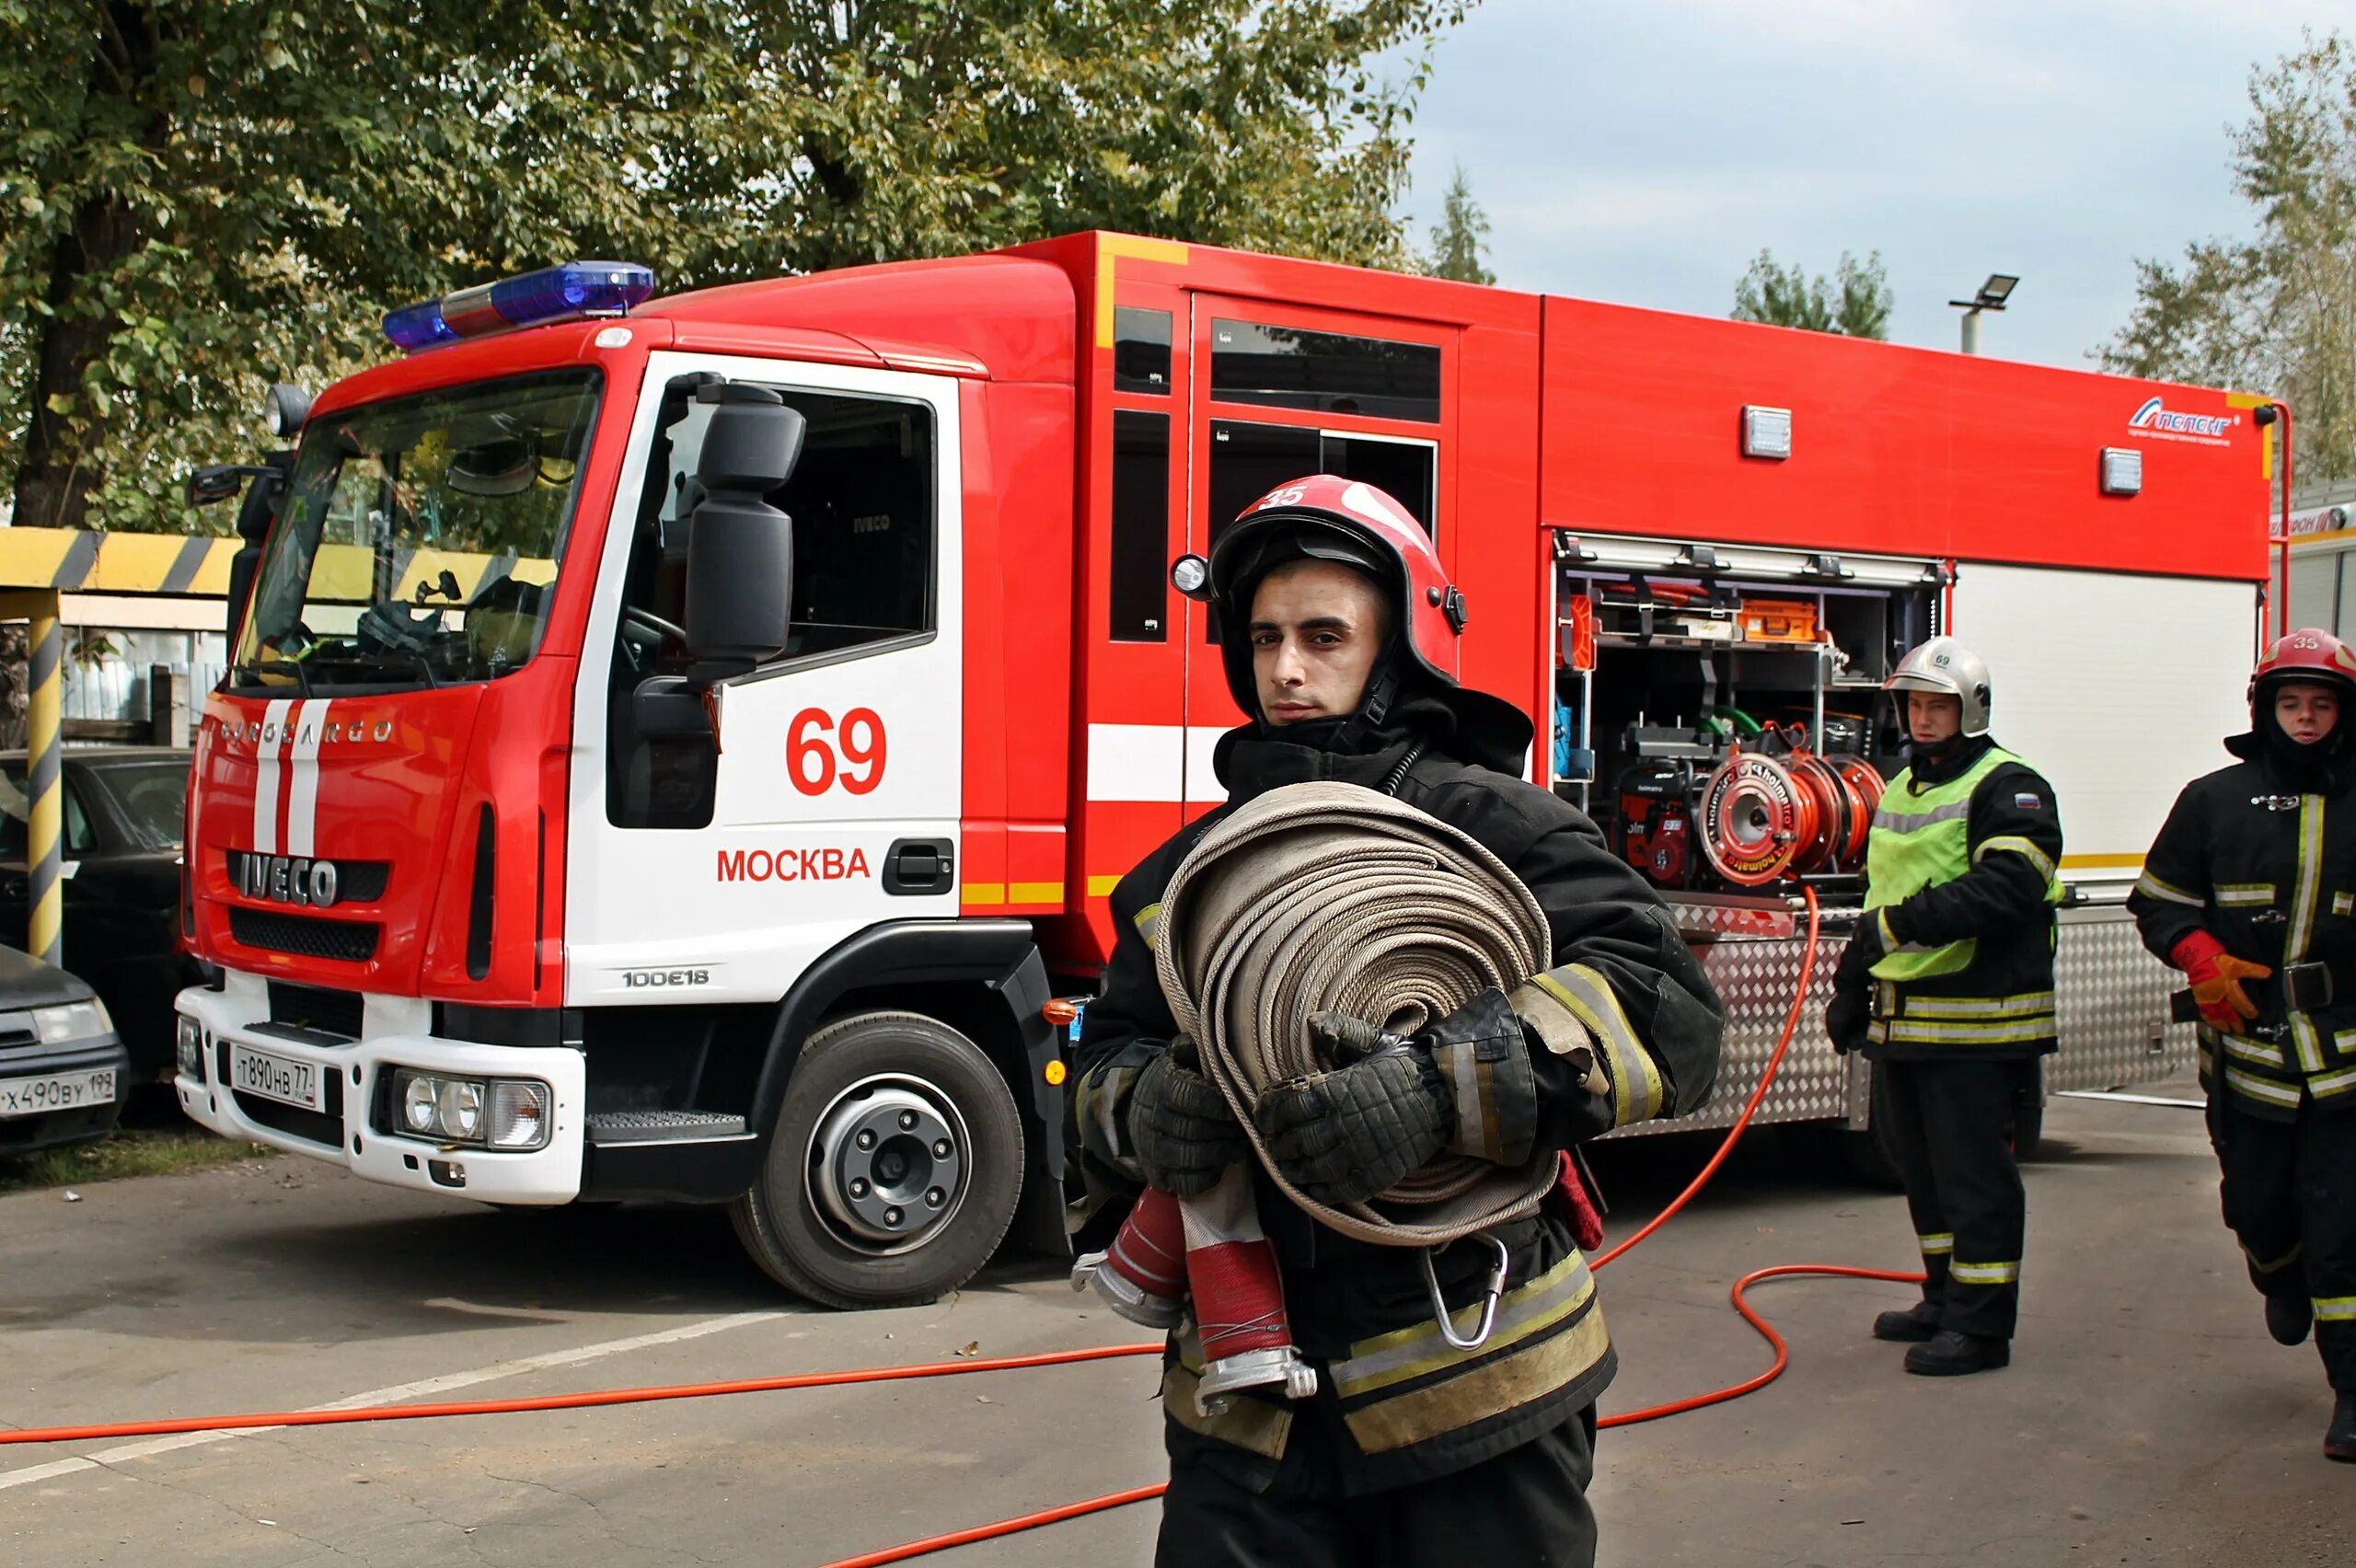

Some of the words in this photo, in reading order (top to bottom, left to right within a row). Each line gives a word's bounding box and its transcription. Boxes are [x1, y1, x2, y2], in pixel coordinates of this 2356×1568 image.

[1258, 485, 1308, 510] 35
[2293, 637, 2318, 650] 35
[1935, 654, 1950, 665] 69
[221, 721, 392, 745] EUROCARGO
[786, 707, 887, 796] 69
[717, 847, 871, 882] МОСКВА
[239, 853, 338, 908] IVECO
[622, 969, 710, 988] 100E18
